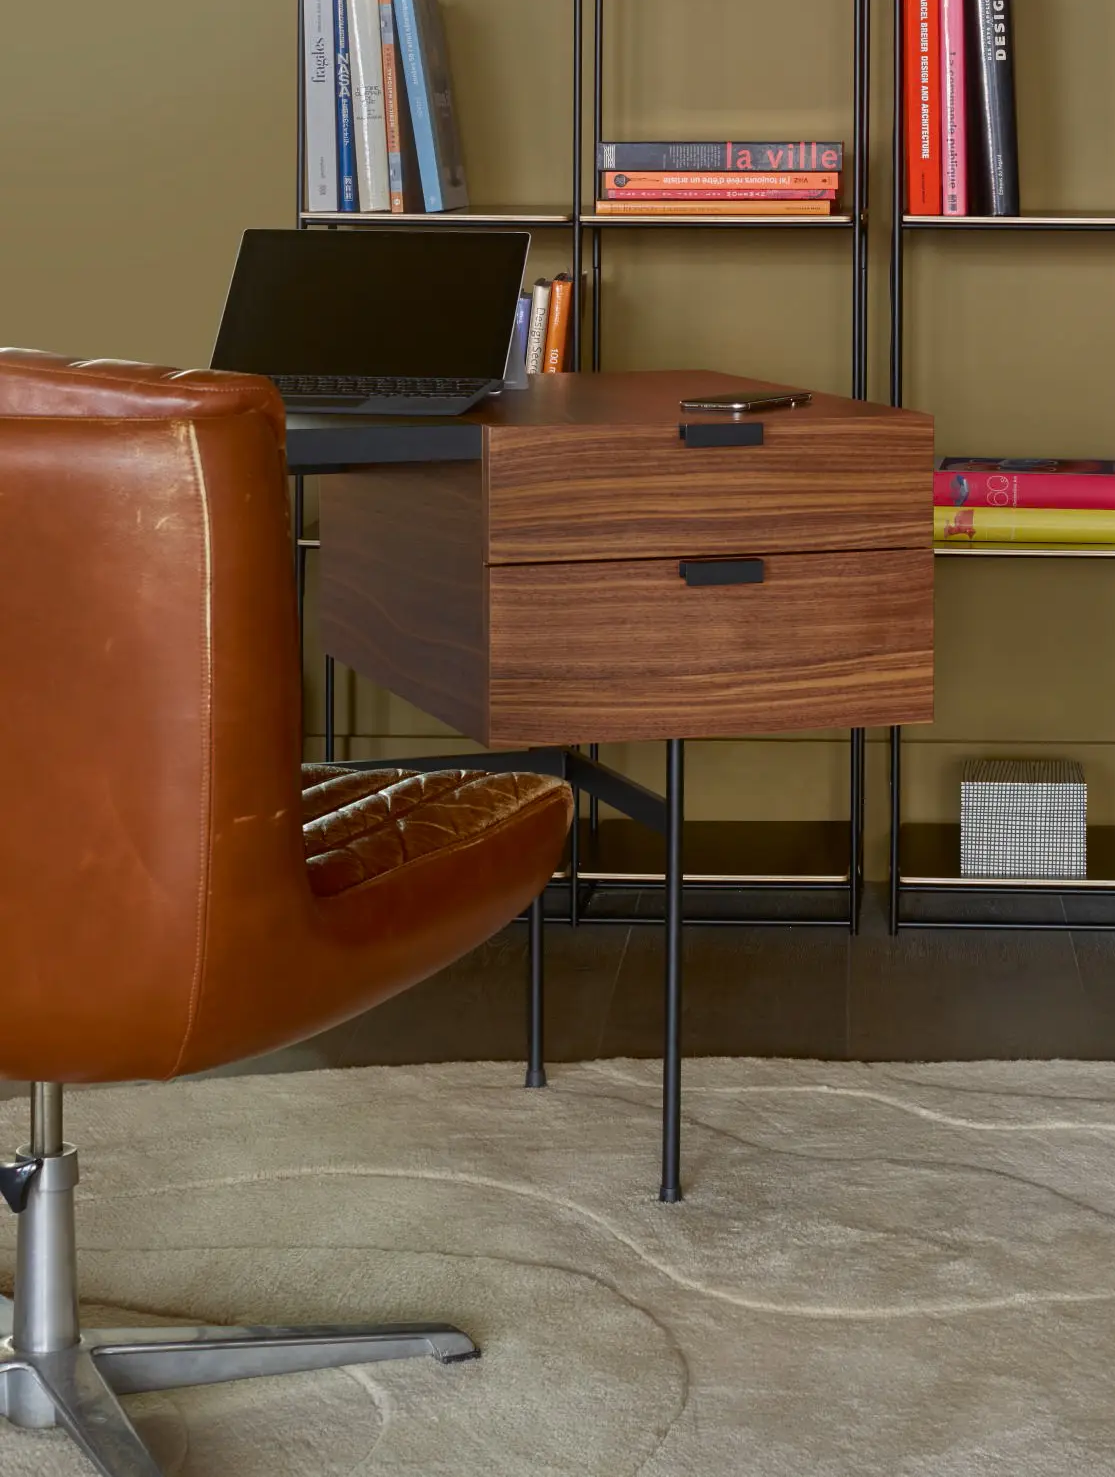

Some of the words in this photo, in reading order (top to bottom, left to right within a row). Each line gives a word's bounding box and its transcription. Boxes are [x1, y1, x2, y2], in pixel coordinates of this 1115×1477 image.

[920, 22, 928, 52] BREUER
[311, 37, 328, 83] fragiles
[337, 52, 351, 97] NASA
[921, 56, 929, 83] DESIGN
[921, 86, 929, 101] AND
[921, 103, 930, 159] ARCHITECTURE
[726, 141, 752, 169] la
[767, 141, 839, 169] ville
[946, 138, 957, 189] publique
[745, 176, 777, 184] toujours
[531, 307, 546, 344] Design
[550, 348, 559, 364] 100
